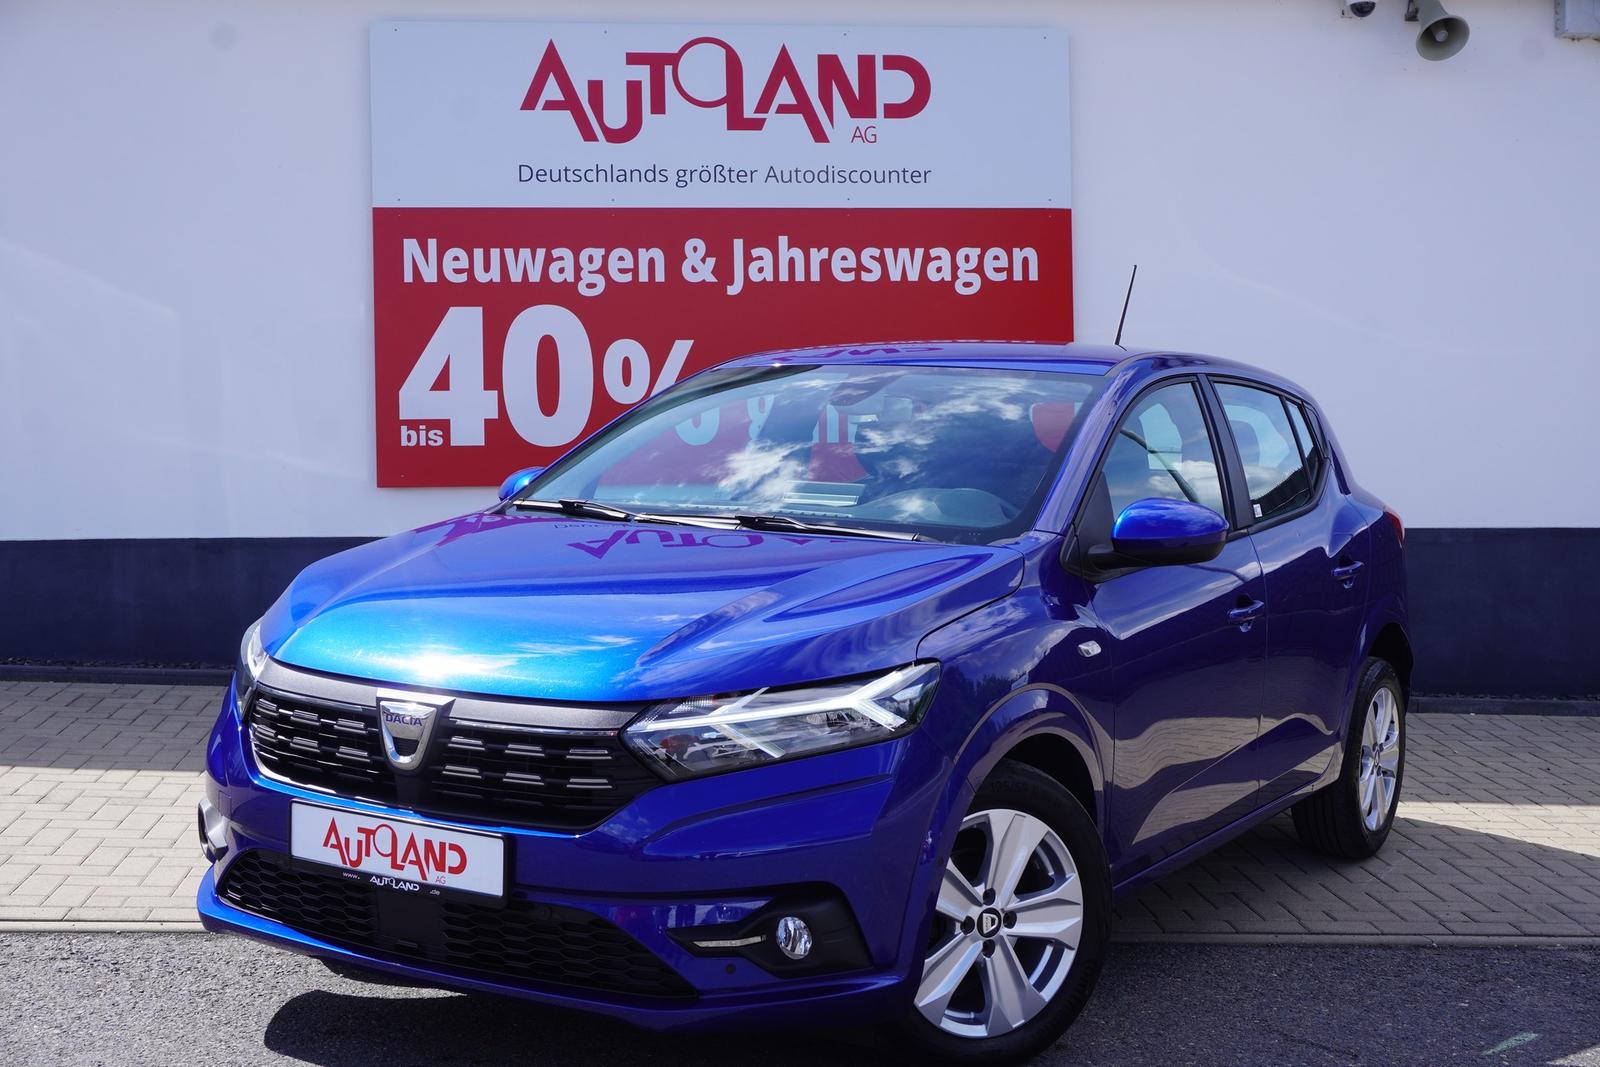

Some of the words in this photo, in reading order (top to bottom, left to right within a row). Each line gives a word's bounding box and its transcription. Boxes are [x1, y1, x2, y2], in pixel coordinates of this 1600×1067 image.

[519, 36, 932, 144] AUTOLAND
[850, 125, 877, 143] AG
[518, 164, 669, 183] Deutschlands
[675, 164, 758, 188] größter
[764, 165, 932, 184] Autodiscounter
[402, 238, 665, 297] Neuwagen
[681, 237, 718, 283] &
[727, 235, 1039, 296] Jahreswagen
[400, 425, 444, 447] bis
[385, 712, 423, 727] DACIA
[322, 816, 468, 882] AUTOLAND
[342, 871, 361, 881] www.
[369, 875, 420, 892] AUTOLAND
[429, 888, 441, 896] .de
[435, 875, 447, 886] AG
